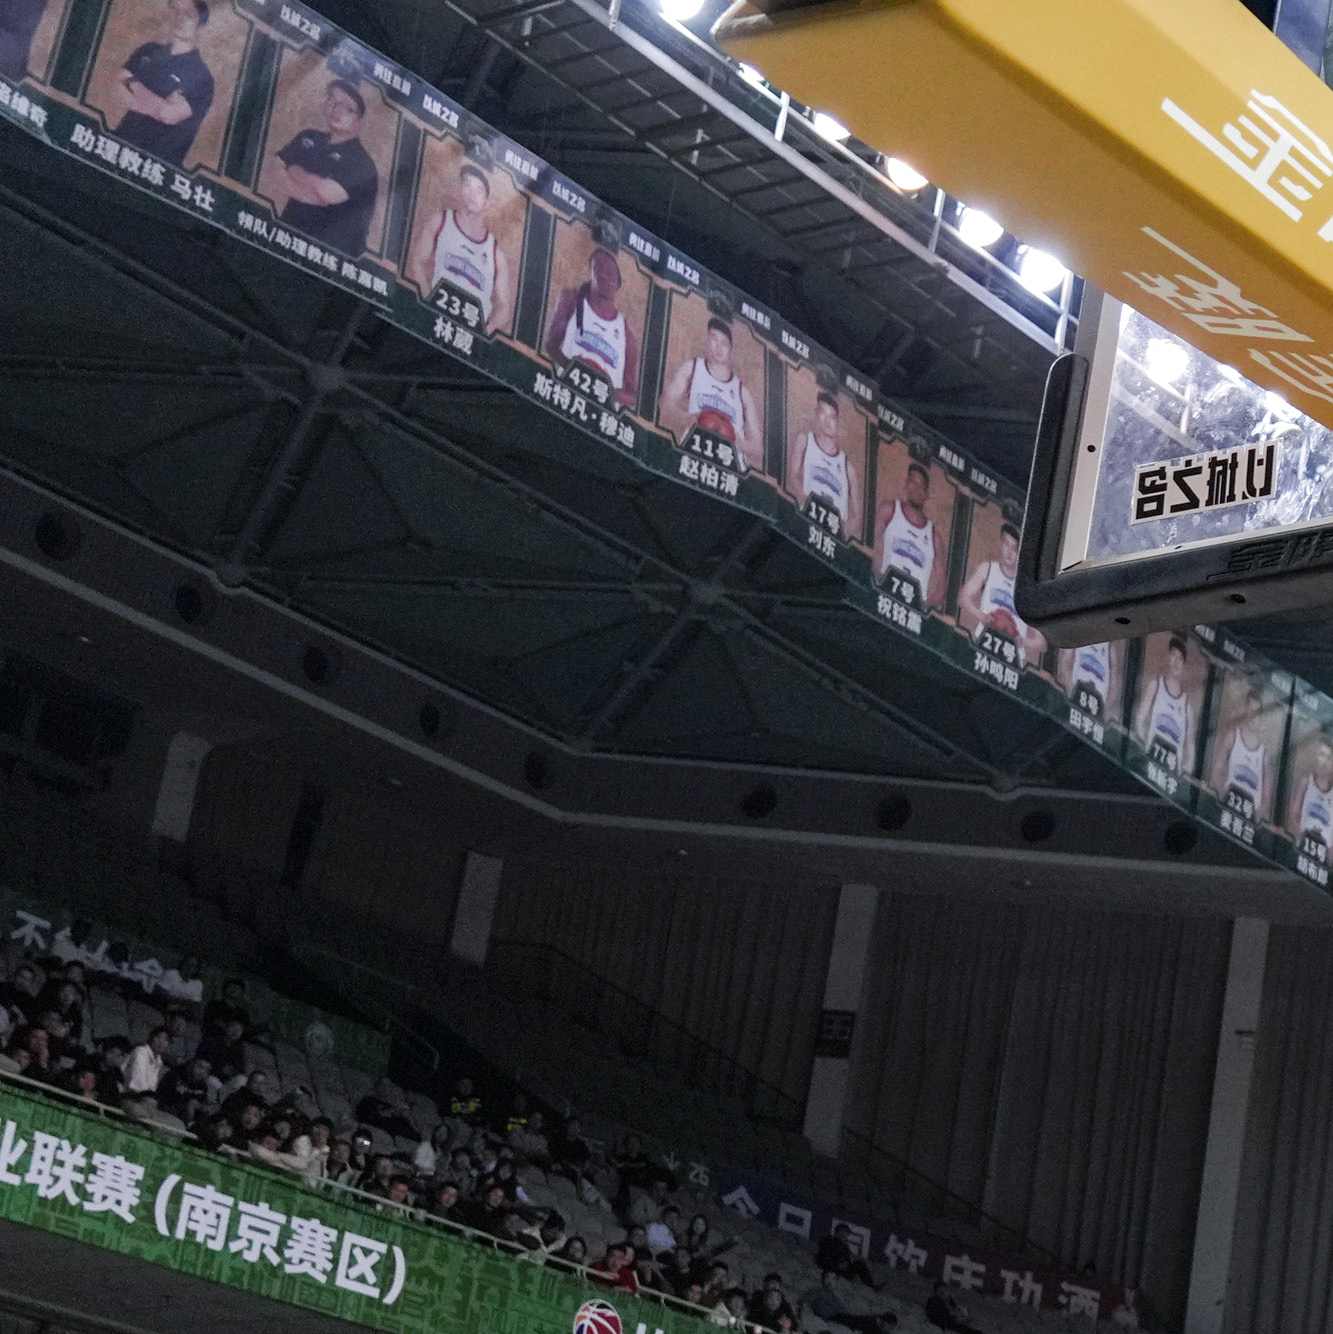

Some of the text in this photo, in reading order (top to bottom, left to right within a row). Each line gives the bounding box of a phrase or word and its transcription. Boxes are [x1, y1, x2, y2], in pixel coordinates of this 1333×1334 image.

[70, 122, 167, 187] 助理教练
[435, 288, 481, 328] 23号
[568, 367, 611, 405] 42号
[691, 433, 736, 467] 11号
[679, 454, 740, 497] 赵柏清
[808, 501, 842, 535] 17号
[891, 576, 916, 605] 7号
[981, 631, 1018, 664] 27号
